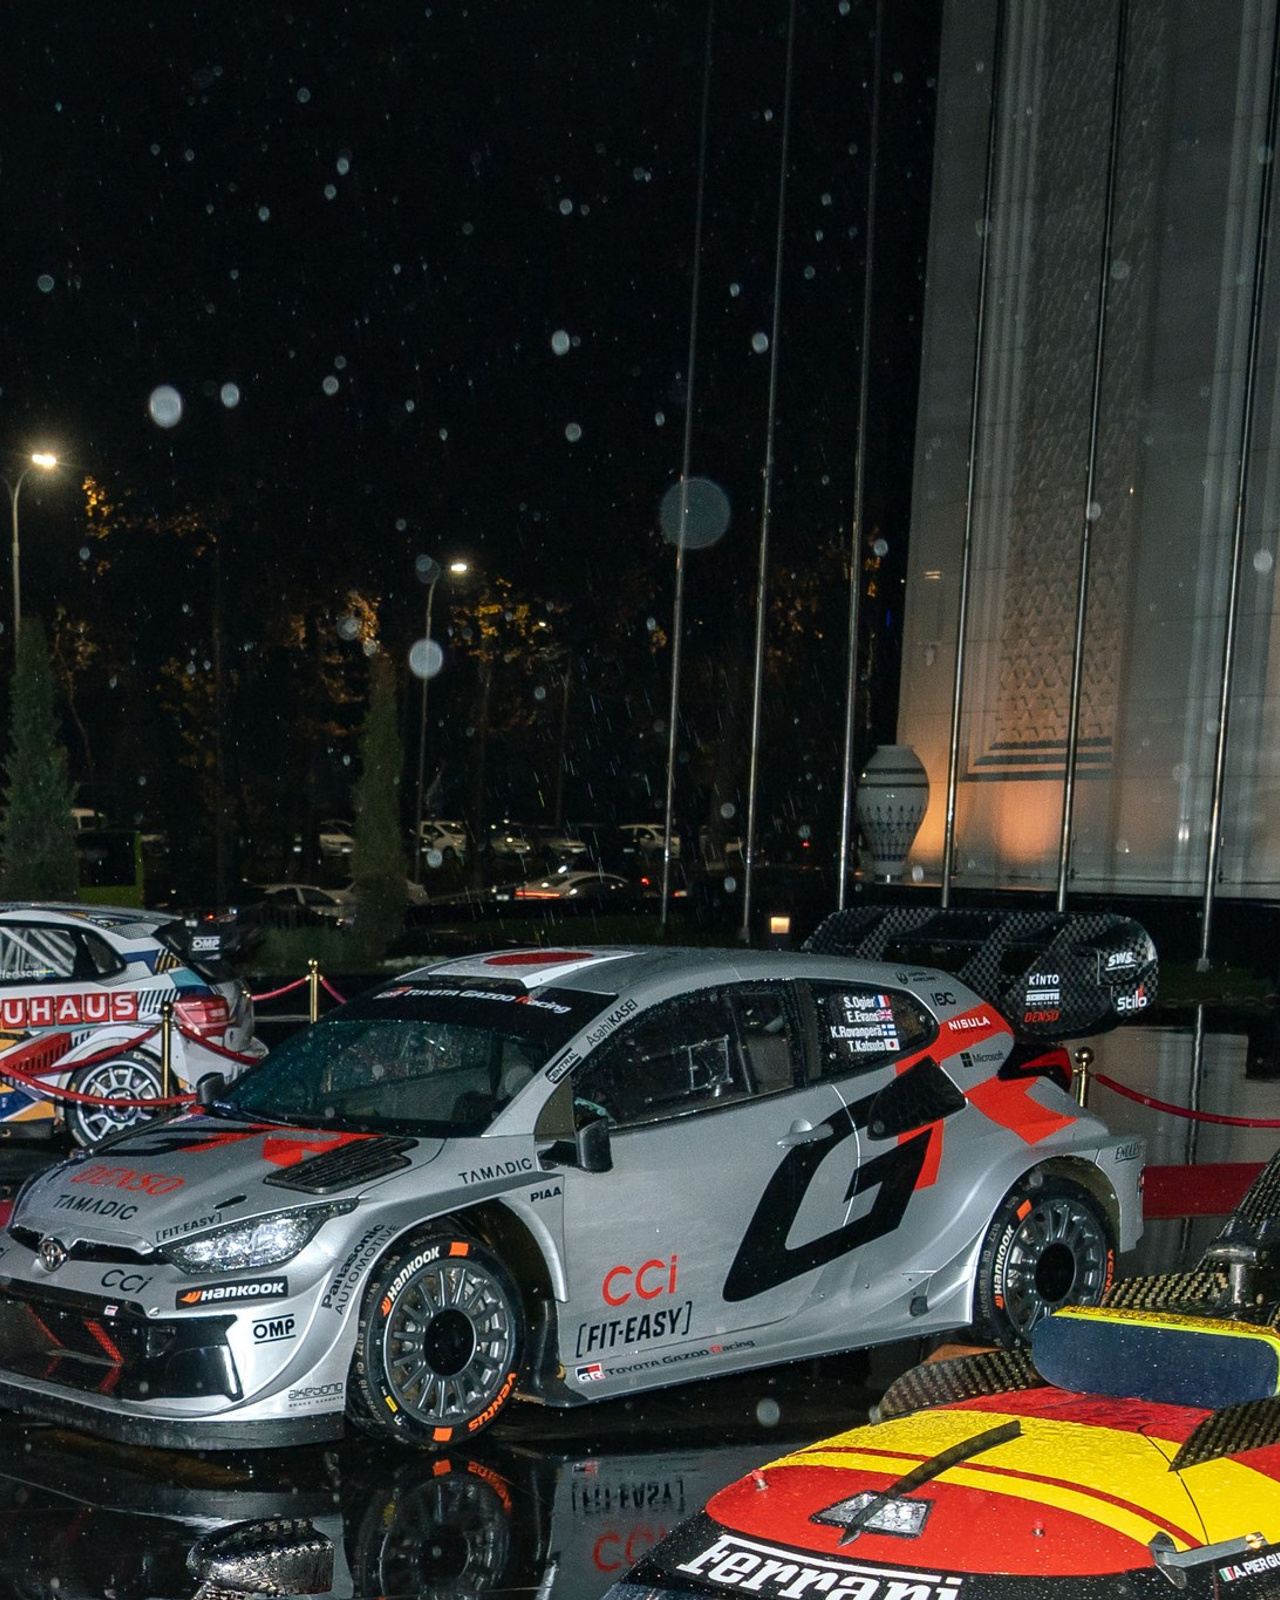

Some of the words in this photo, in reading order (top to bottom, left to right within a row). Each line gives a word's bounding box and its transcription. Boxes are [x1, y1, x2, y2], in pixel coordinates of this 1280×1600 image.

[192, 938, 221, 949] OMP
[1028, 973, 1060, 986] KINTO
[460, 990, 516, 1002] GAZOO
[846, 1010, 879, 1023] E.Evans
[948, 1016, 991, 1031] NISULA
[1023, 1009, 1060, 1023] DENSO
[548, 1052, 579, 1081] CENTRAL
[70, 1165, 186, 1196] DENSO
[530, 1186, 562, 1202] PIAA
[320, 1223, 386, 1310] Panasonic
[335, 1223, 402, 1316] AUTOMOTIVE
[253, 1321, 296, 1340] OMP
[605, 1360, 661, 1376] TOYOTA
[662, 1349, 710, 1364] GAZOO
[710, 1338, 756, 1354] Racing
